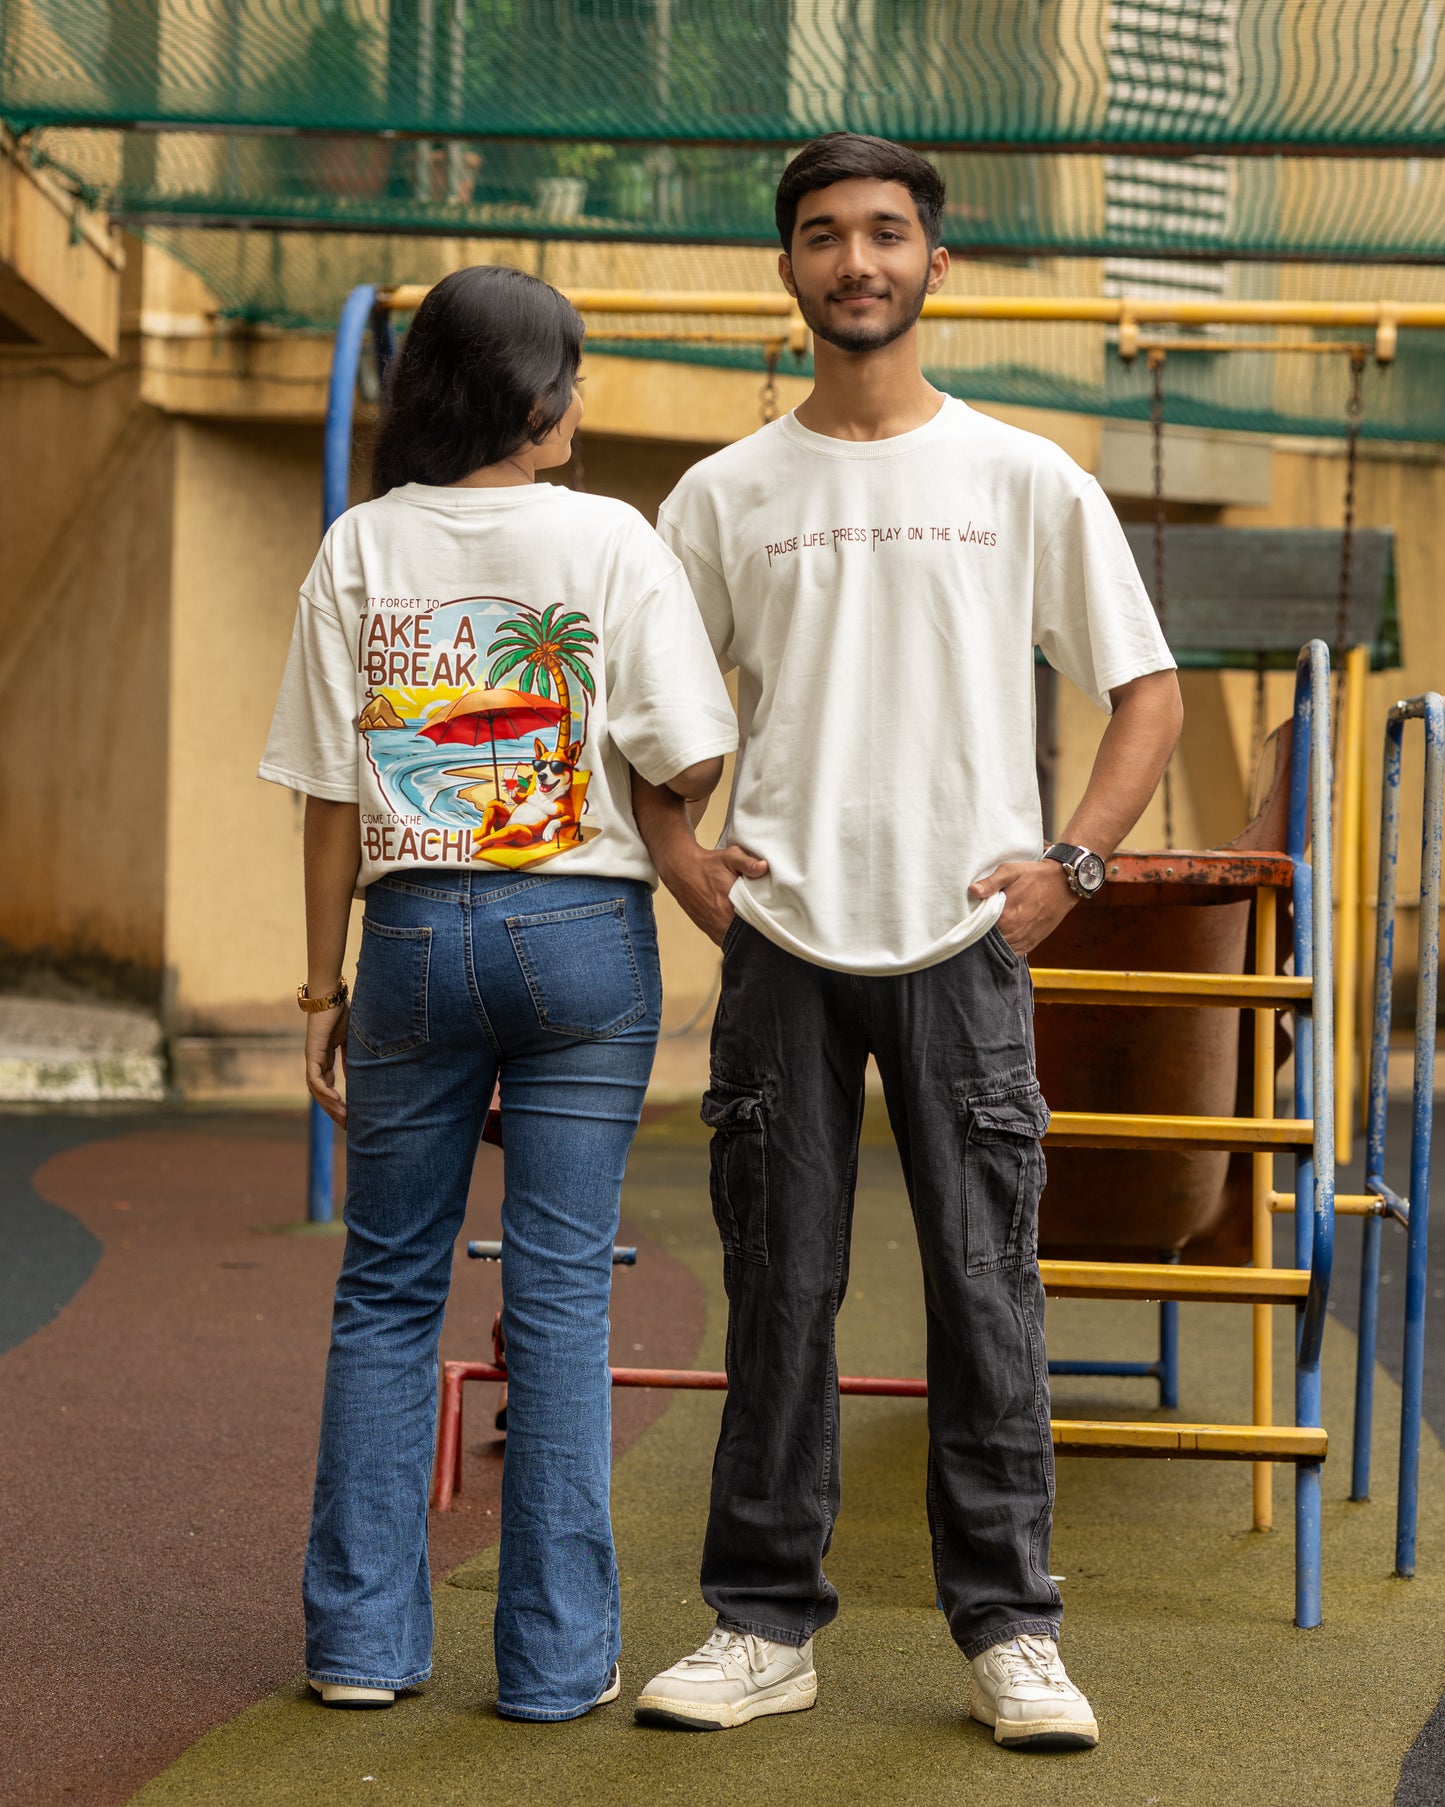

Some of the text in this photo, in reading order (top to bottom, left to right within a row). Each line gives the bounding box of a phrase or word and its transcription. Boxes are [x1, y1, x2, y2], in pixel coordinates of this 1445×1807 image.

[765, 521, 998, 568] PAUSE LIFE. PRESS PLAY ON THE WAVES
[380, 597, 421, 609] FORGET
[426, 598, 440, 609] TO
[453, 615, 476, 650] A
[363, 651, 477, 687] BREAK
[361, 814, 422, 826] COME TO THE
[363, 826, 472, 863] BEACH!
